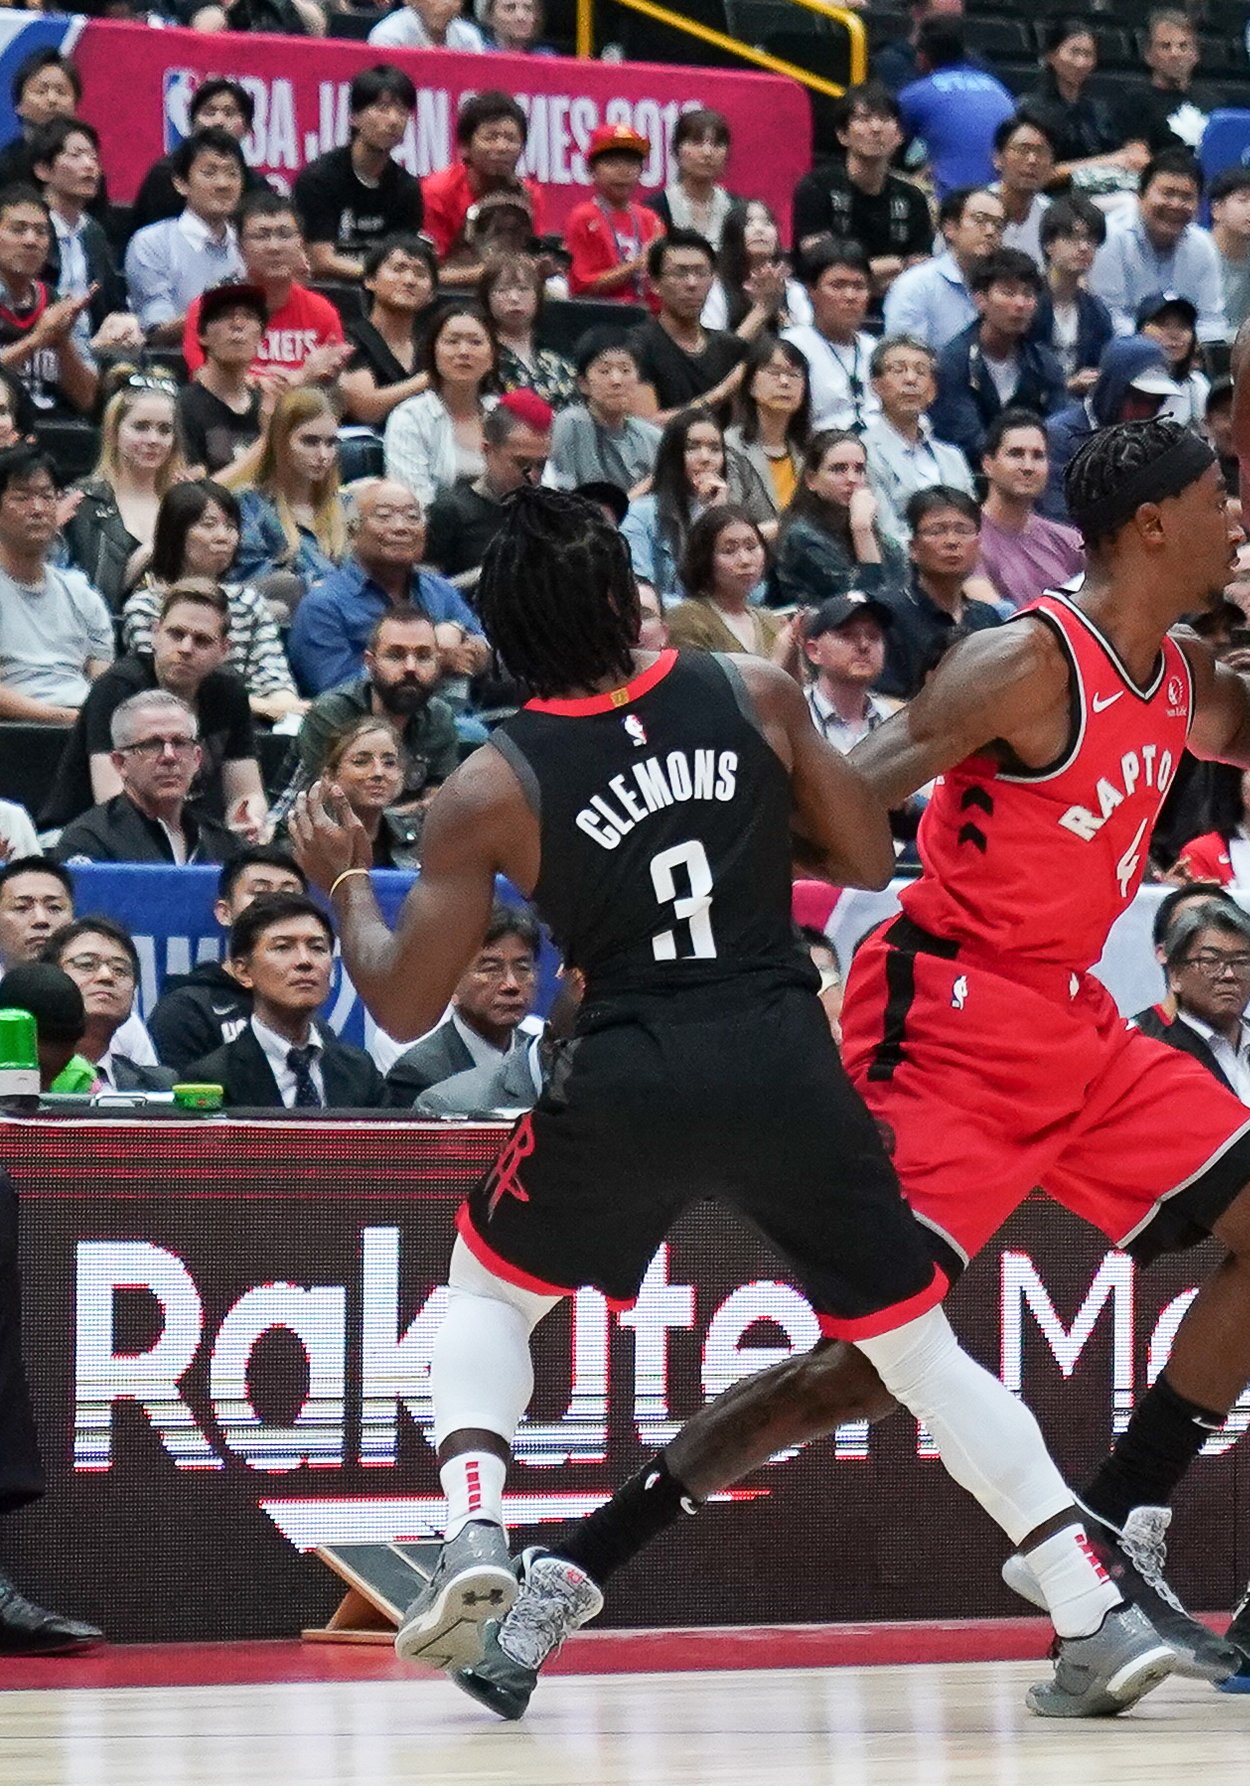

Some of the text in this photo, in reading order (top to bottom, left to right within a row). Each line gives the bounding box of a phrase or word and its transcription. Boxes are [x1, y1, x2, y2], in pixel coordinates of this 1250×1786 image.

[575, 748, 739, 851] CLEMONS
[1058, 744, 1174, 843] RAPTO
[649, 839, 718, 961] 3
[1116, 817, 1149, 899] 4
[73, 1224, 942, 1474] Rakute
